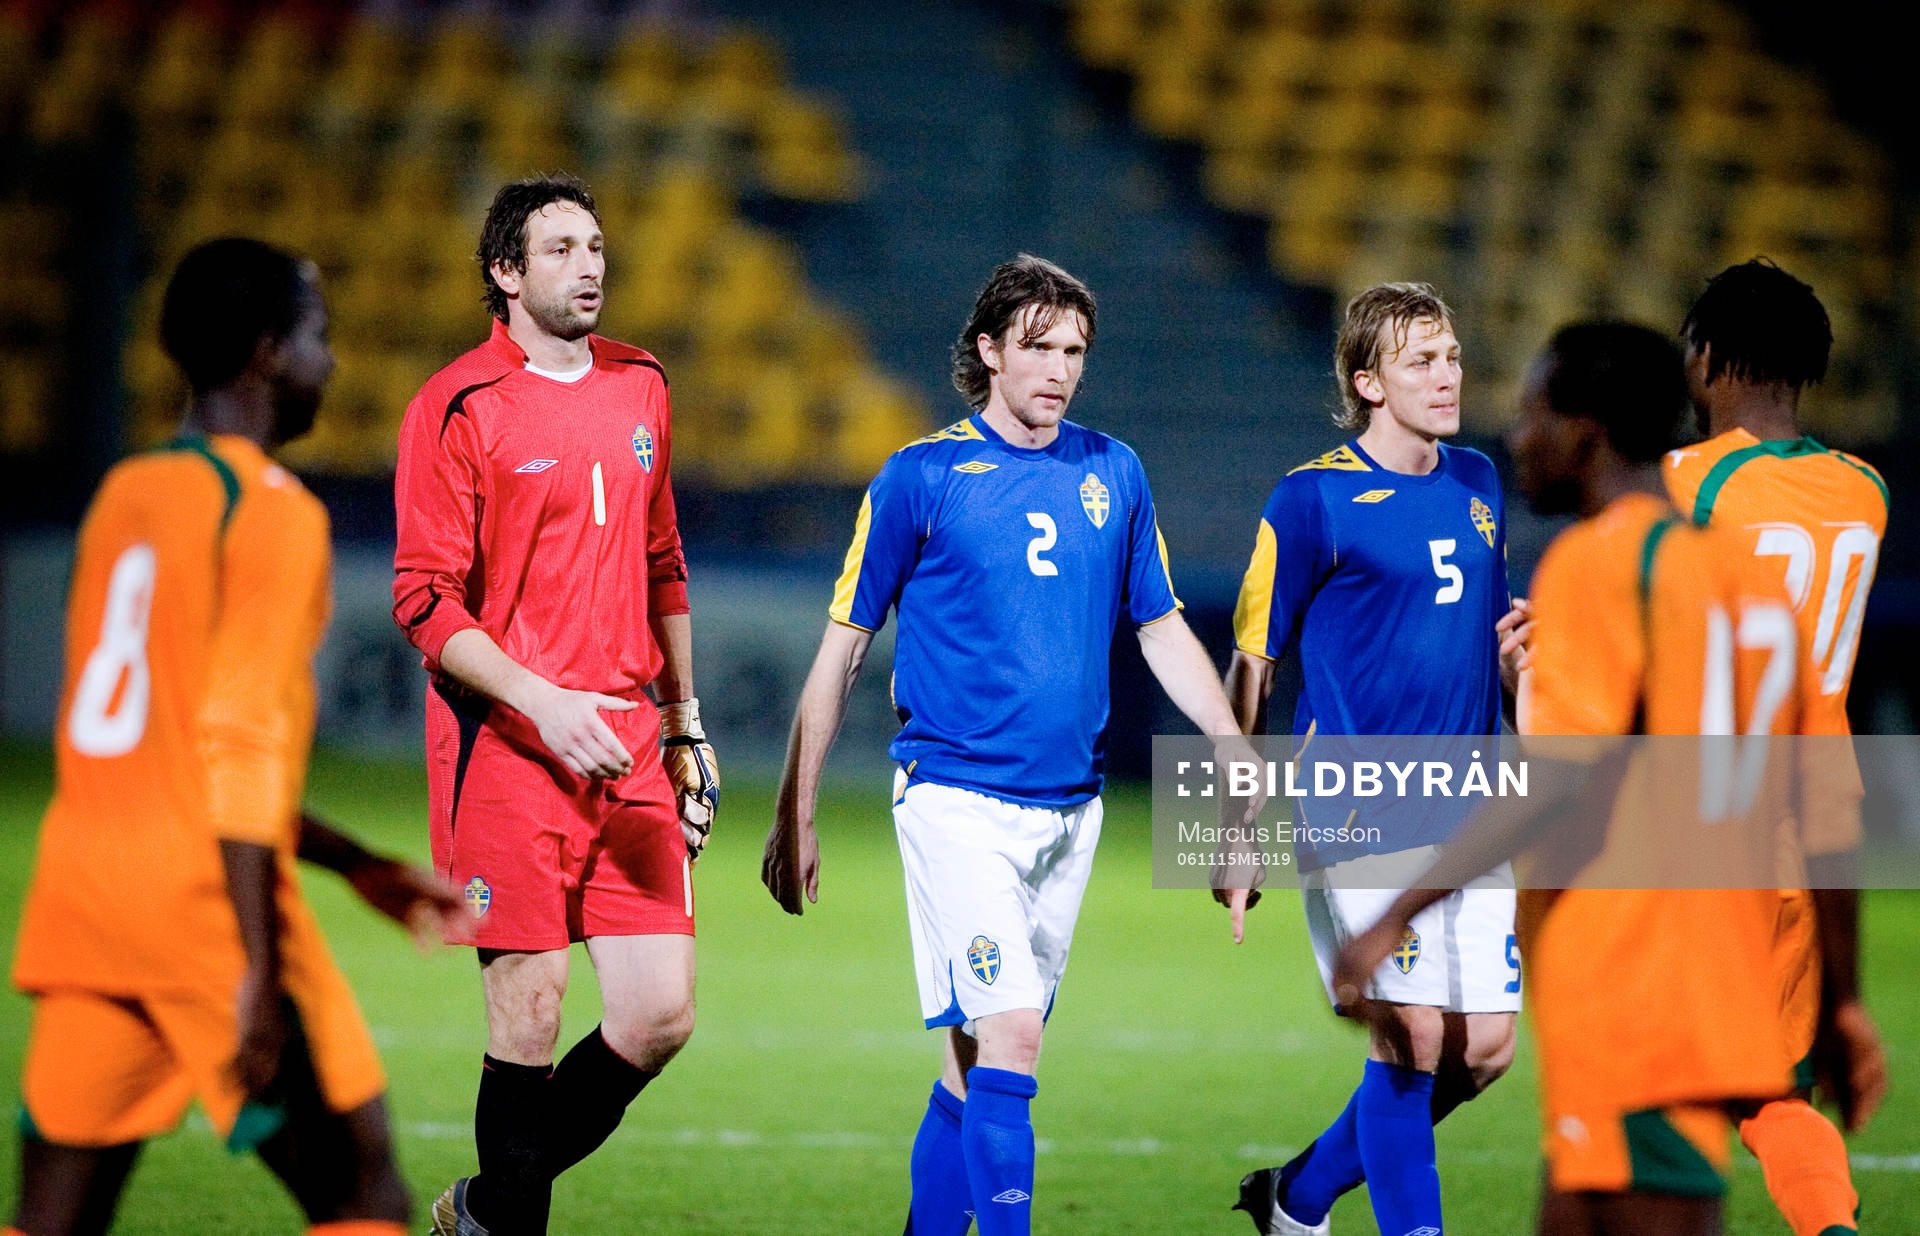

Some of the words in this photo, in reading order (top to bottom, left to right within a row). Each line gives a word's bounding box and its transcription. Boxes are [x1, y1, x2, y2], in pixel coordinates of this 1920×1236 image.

[591, 460, 607, 527] 1
[1025, 511, 1059, 577] 2
[1428, 538, 1464, 605] 5
[68, 544, 157, 758] 8
[1697, 598, 1799, 826] 17
